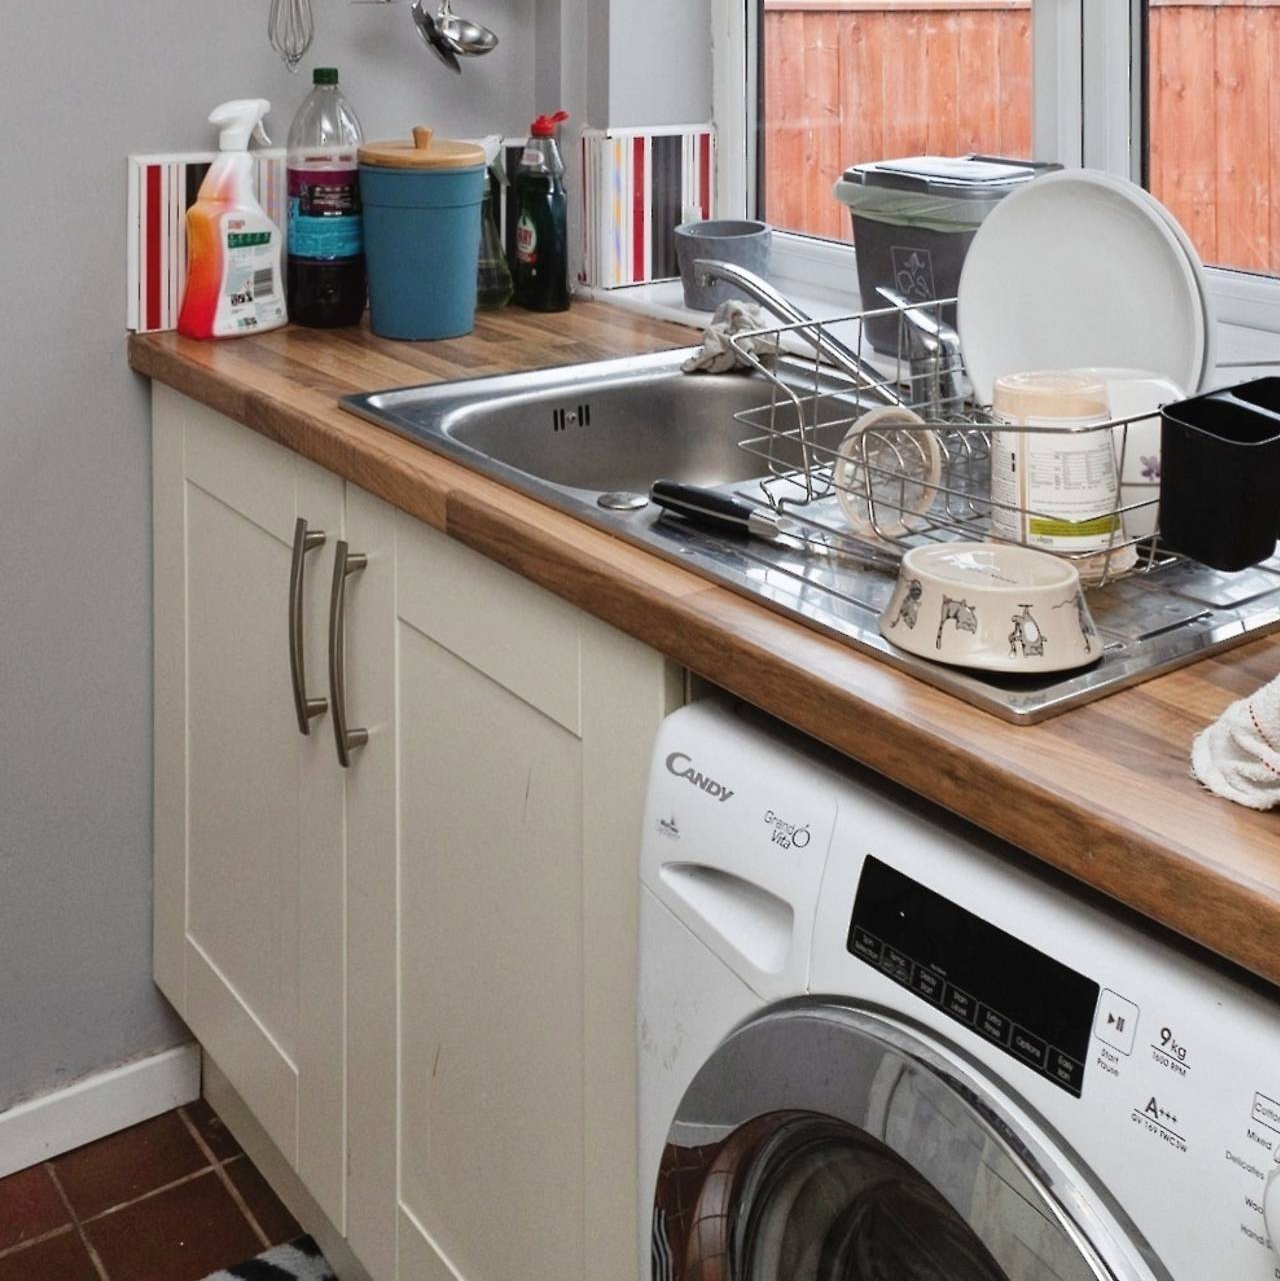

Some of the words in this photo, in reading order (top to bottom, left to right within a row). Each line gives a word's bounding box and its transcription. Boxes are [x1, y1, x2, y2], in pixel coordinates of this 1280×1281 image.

[763, 809, 796, 836] Grand
[771, 829, 793, 850] Vita
[1097, 1057, 1120, 1078] Pause
[1101, 1048, 1119, 1066] Start
[1170, 1061, 1187, 1077] RPM
[1144, 1096, 1178, 1123] A+++
[1246, 1127, 1273, 1151] Mixed
[1225, 1150, 1265, 1181] Delicates
[1244, 1195, 1265, 1215] Woo
